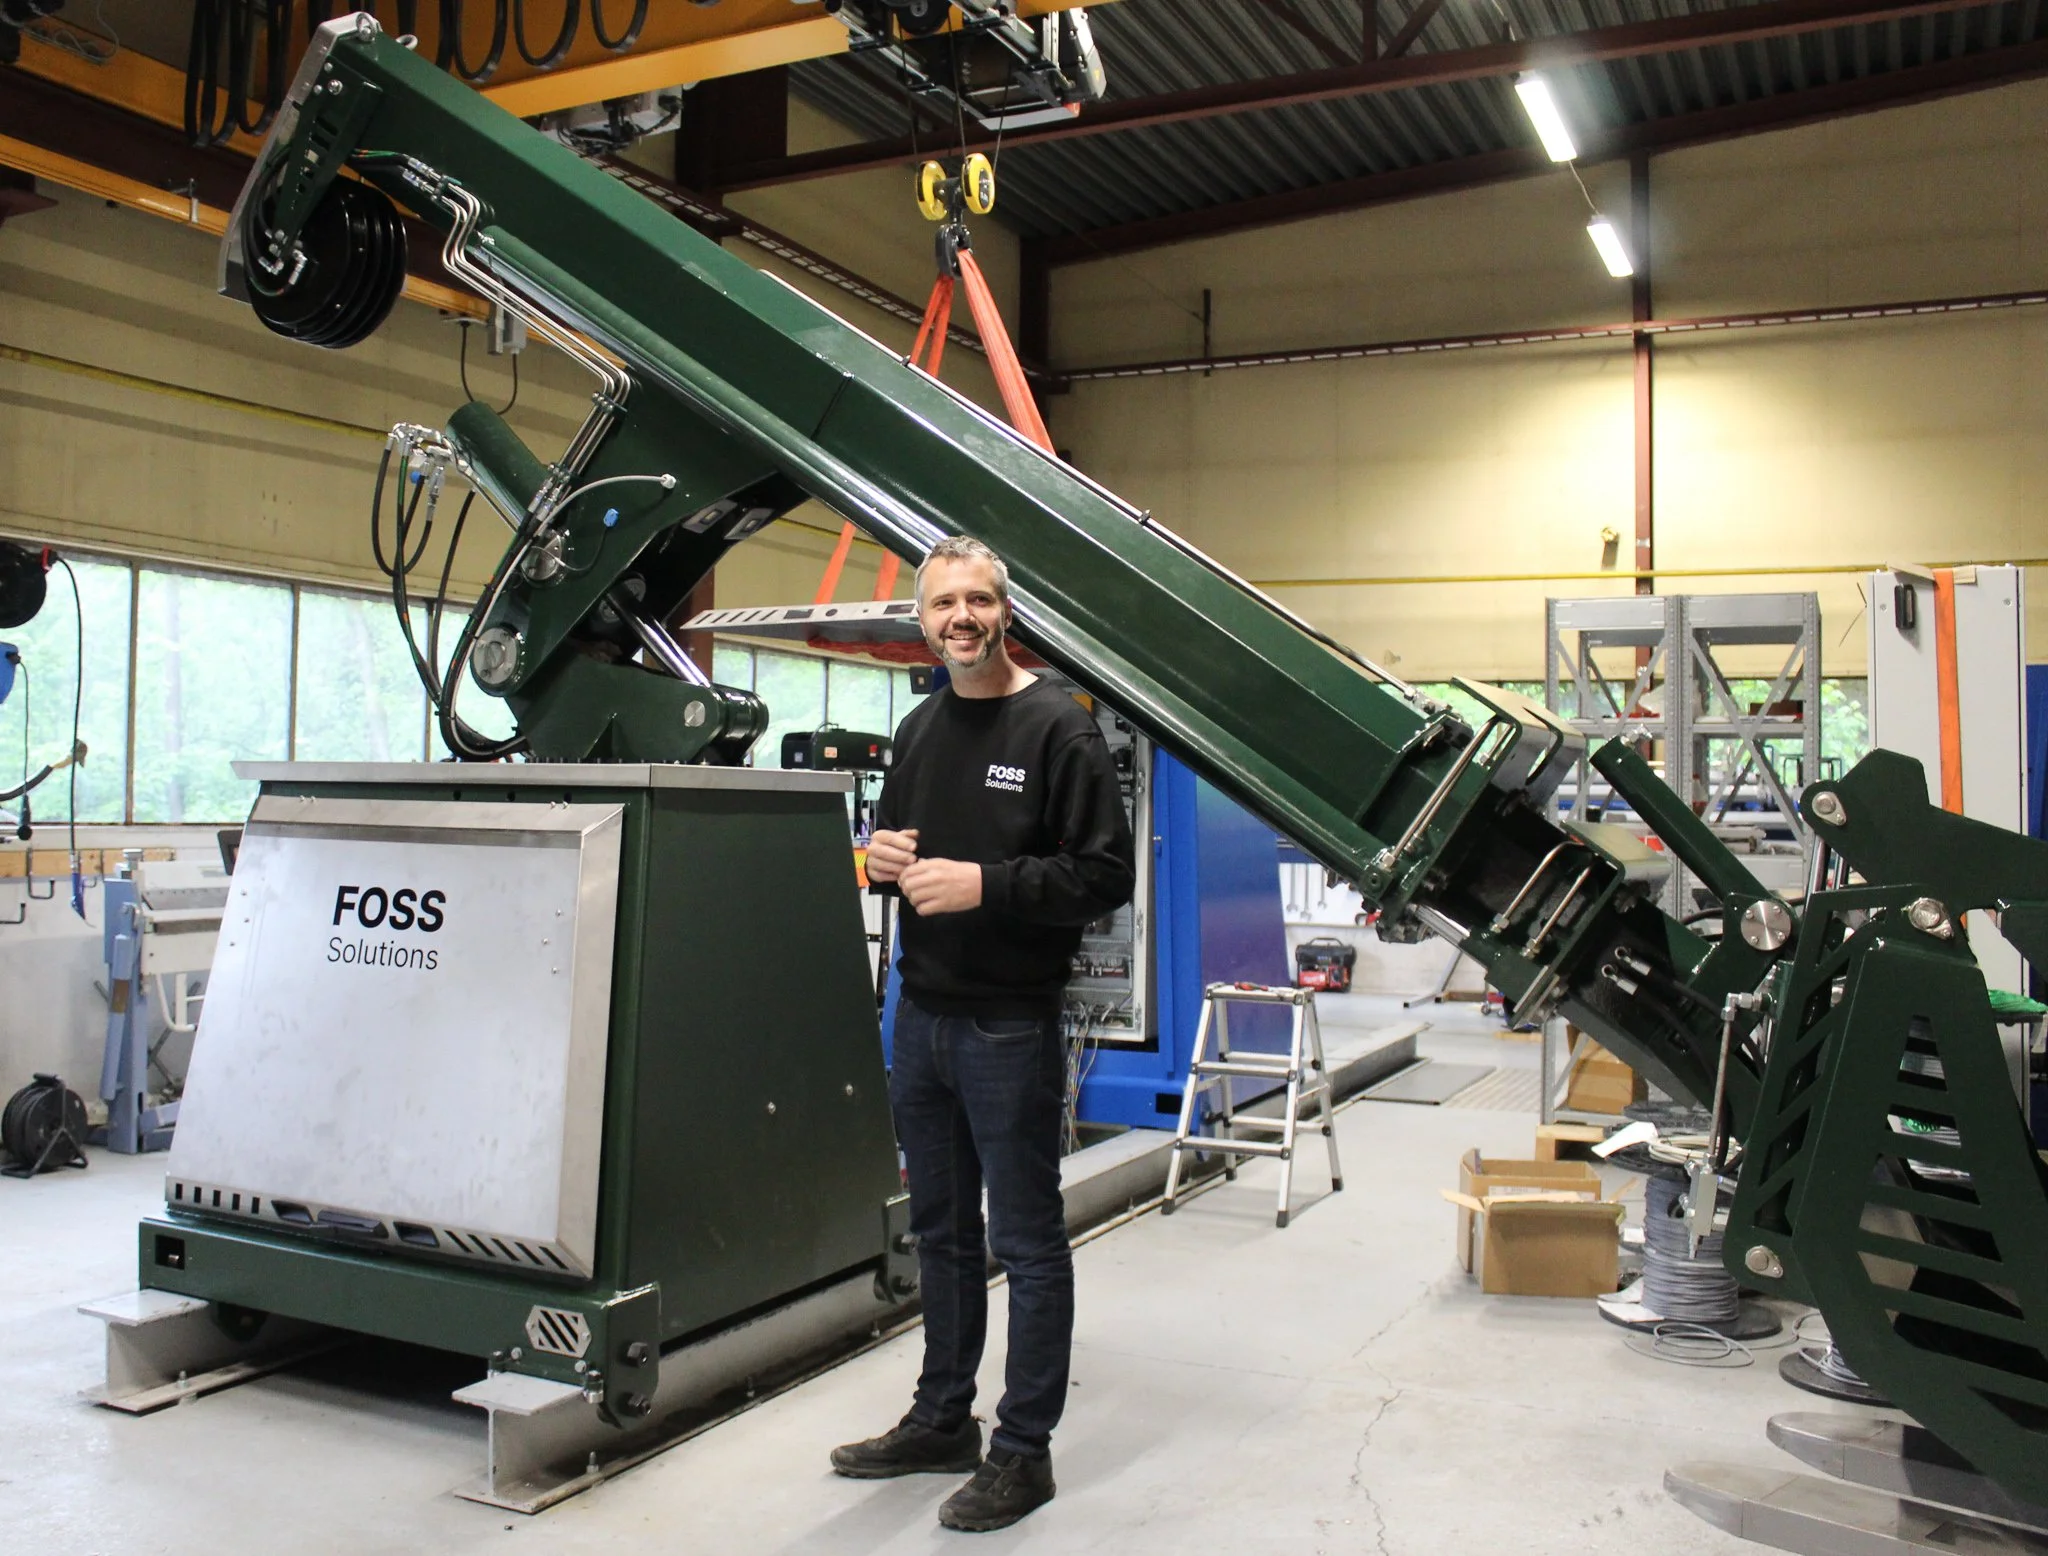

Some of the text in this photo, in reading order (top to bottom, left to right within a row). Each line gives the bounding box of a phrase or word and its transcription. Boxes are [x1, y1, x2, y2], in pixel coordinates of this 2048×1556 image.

[985, 778, 1023, 792] Solutions
[987, 764, 1026, 782] FOSS
[332, 885, 446, 932] FOSS
[327, 936, 438, 970] Solutions
